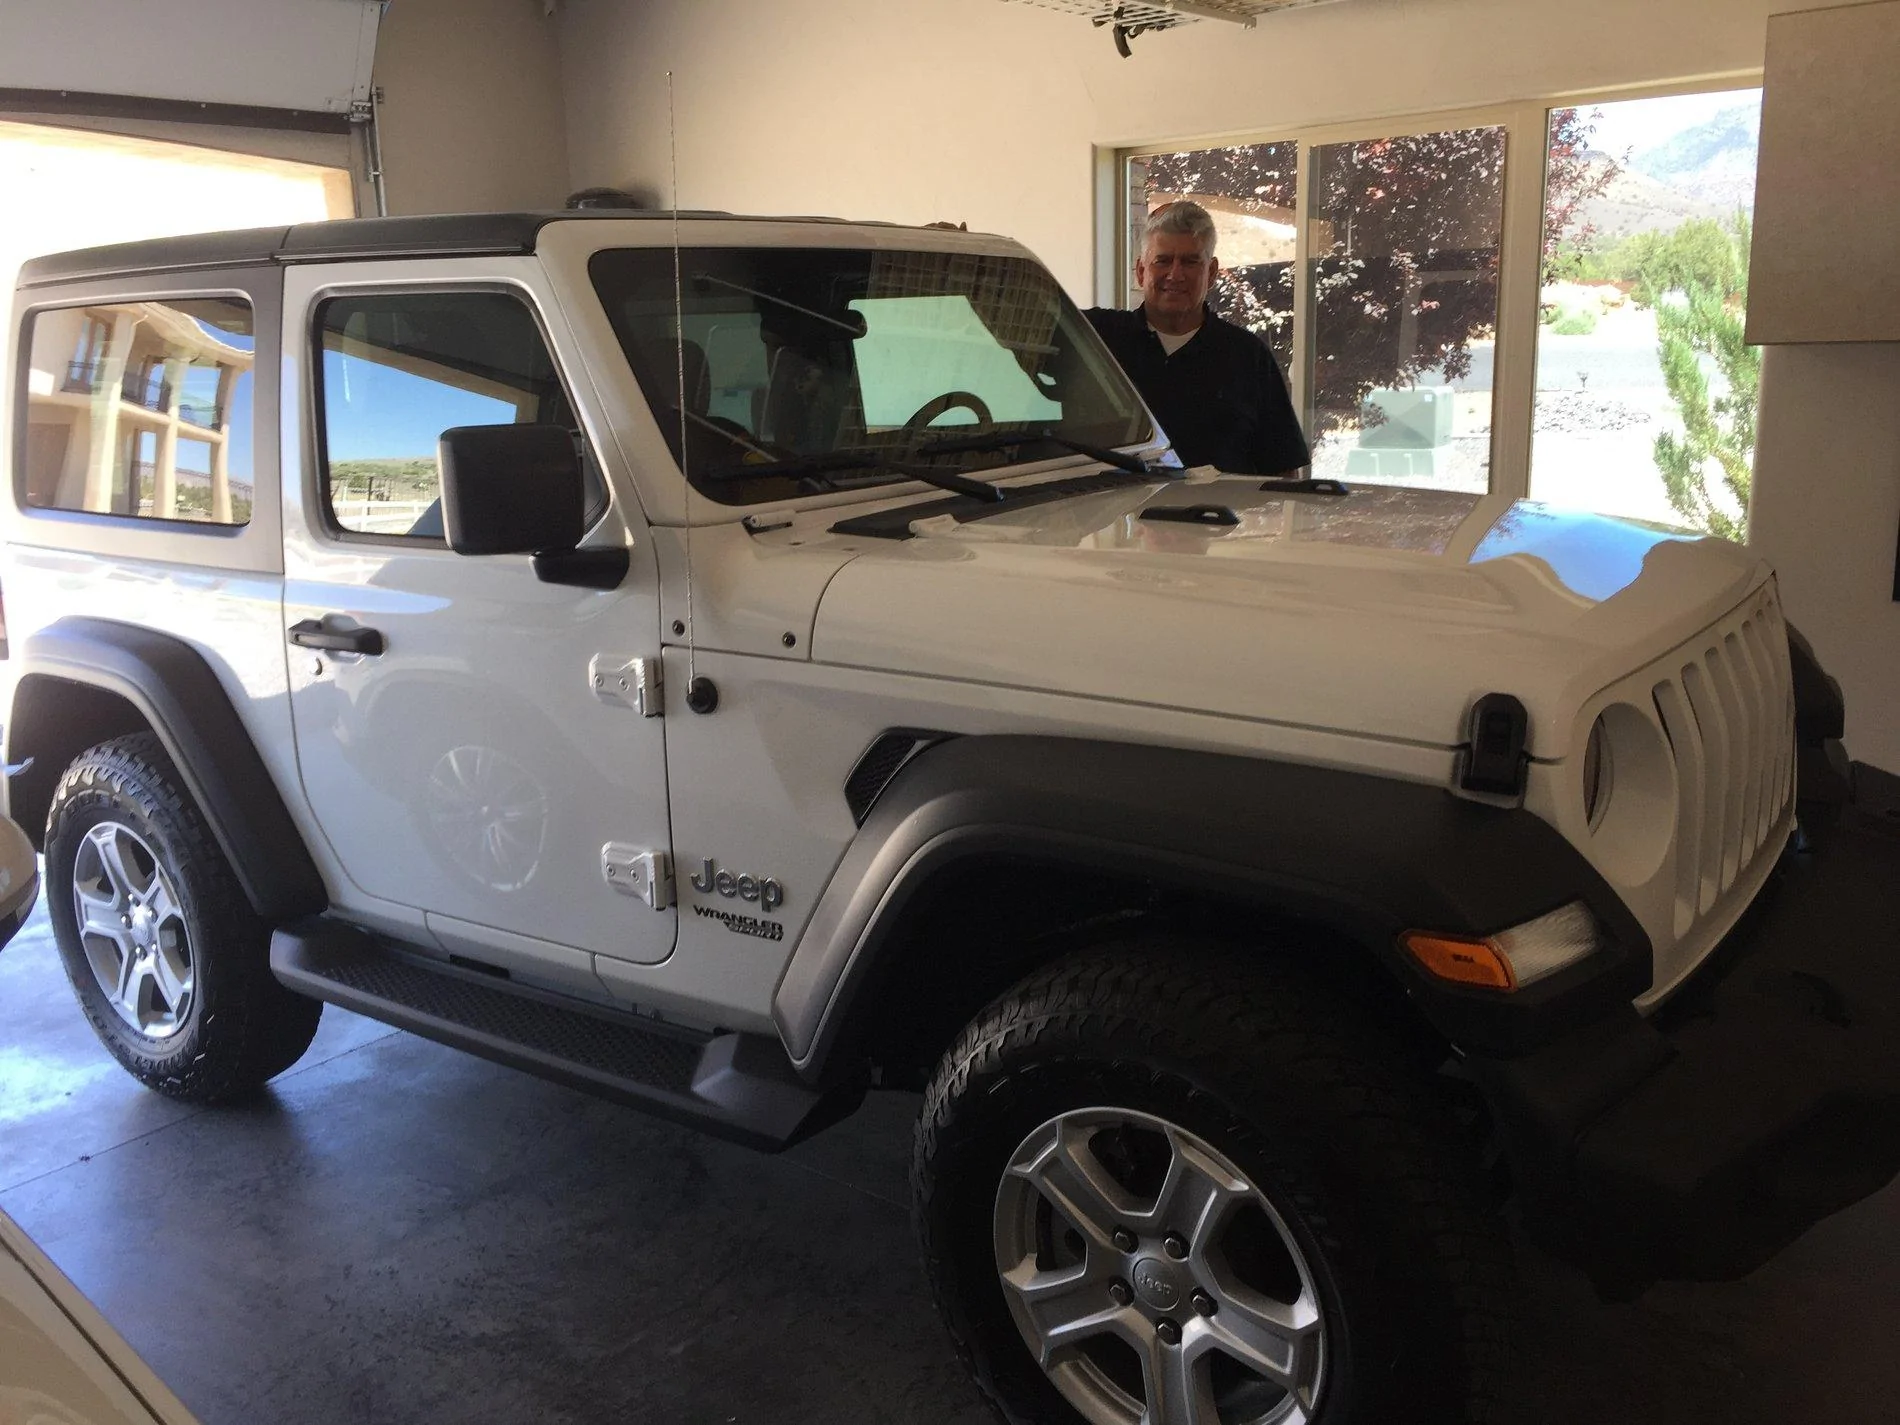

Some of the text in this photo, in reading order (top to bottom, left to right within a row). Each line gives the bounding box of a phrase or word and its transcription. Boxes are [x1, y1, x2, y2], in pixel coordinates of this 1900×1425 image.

[690, 856, 784, 913] Jeep
[693, 904, 784, 934] WRANGLER
[1137, 1272, 1173, 1296] Jeep
